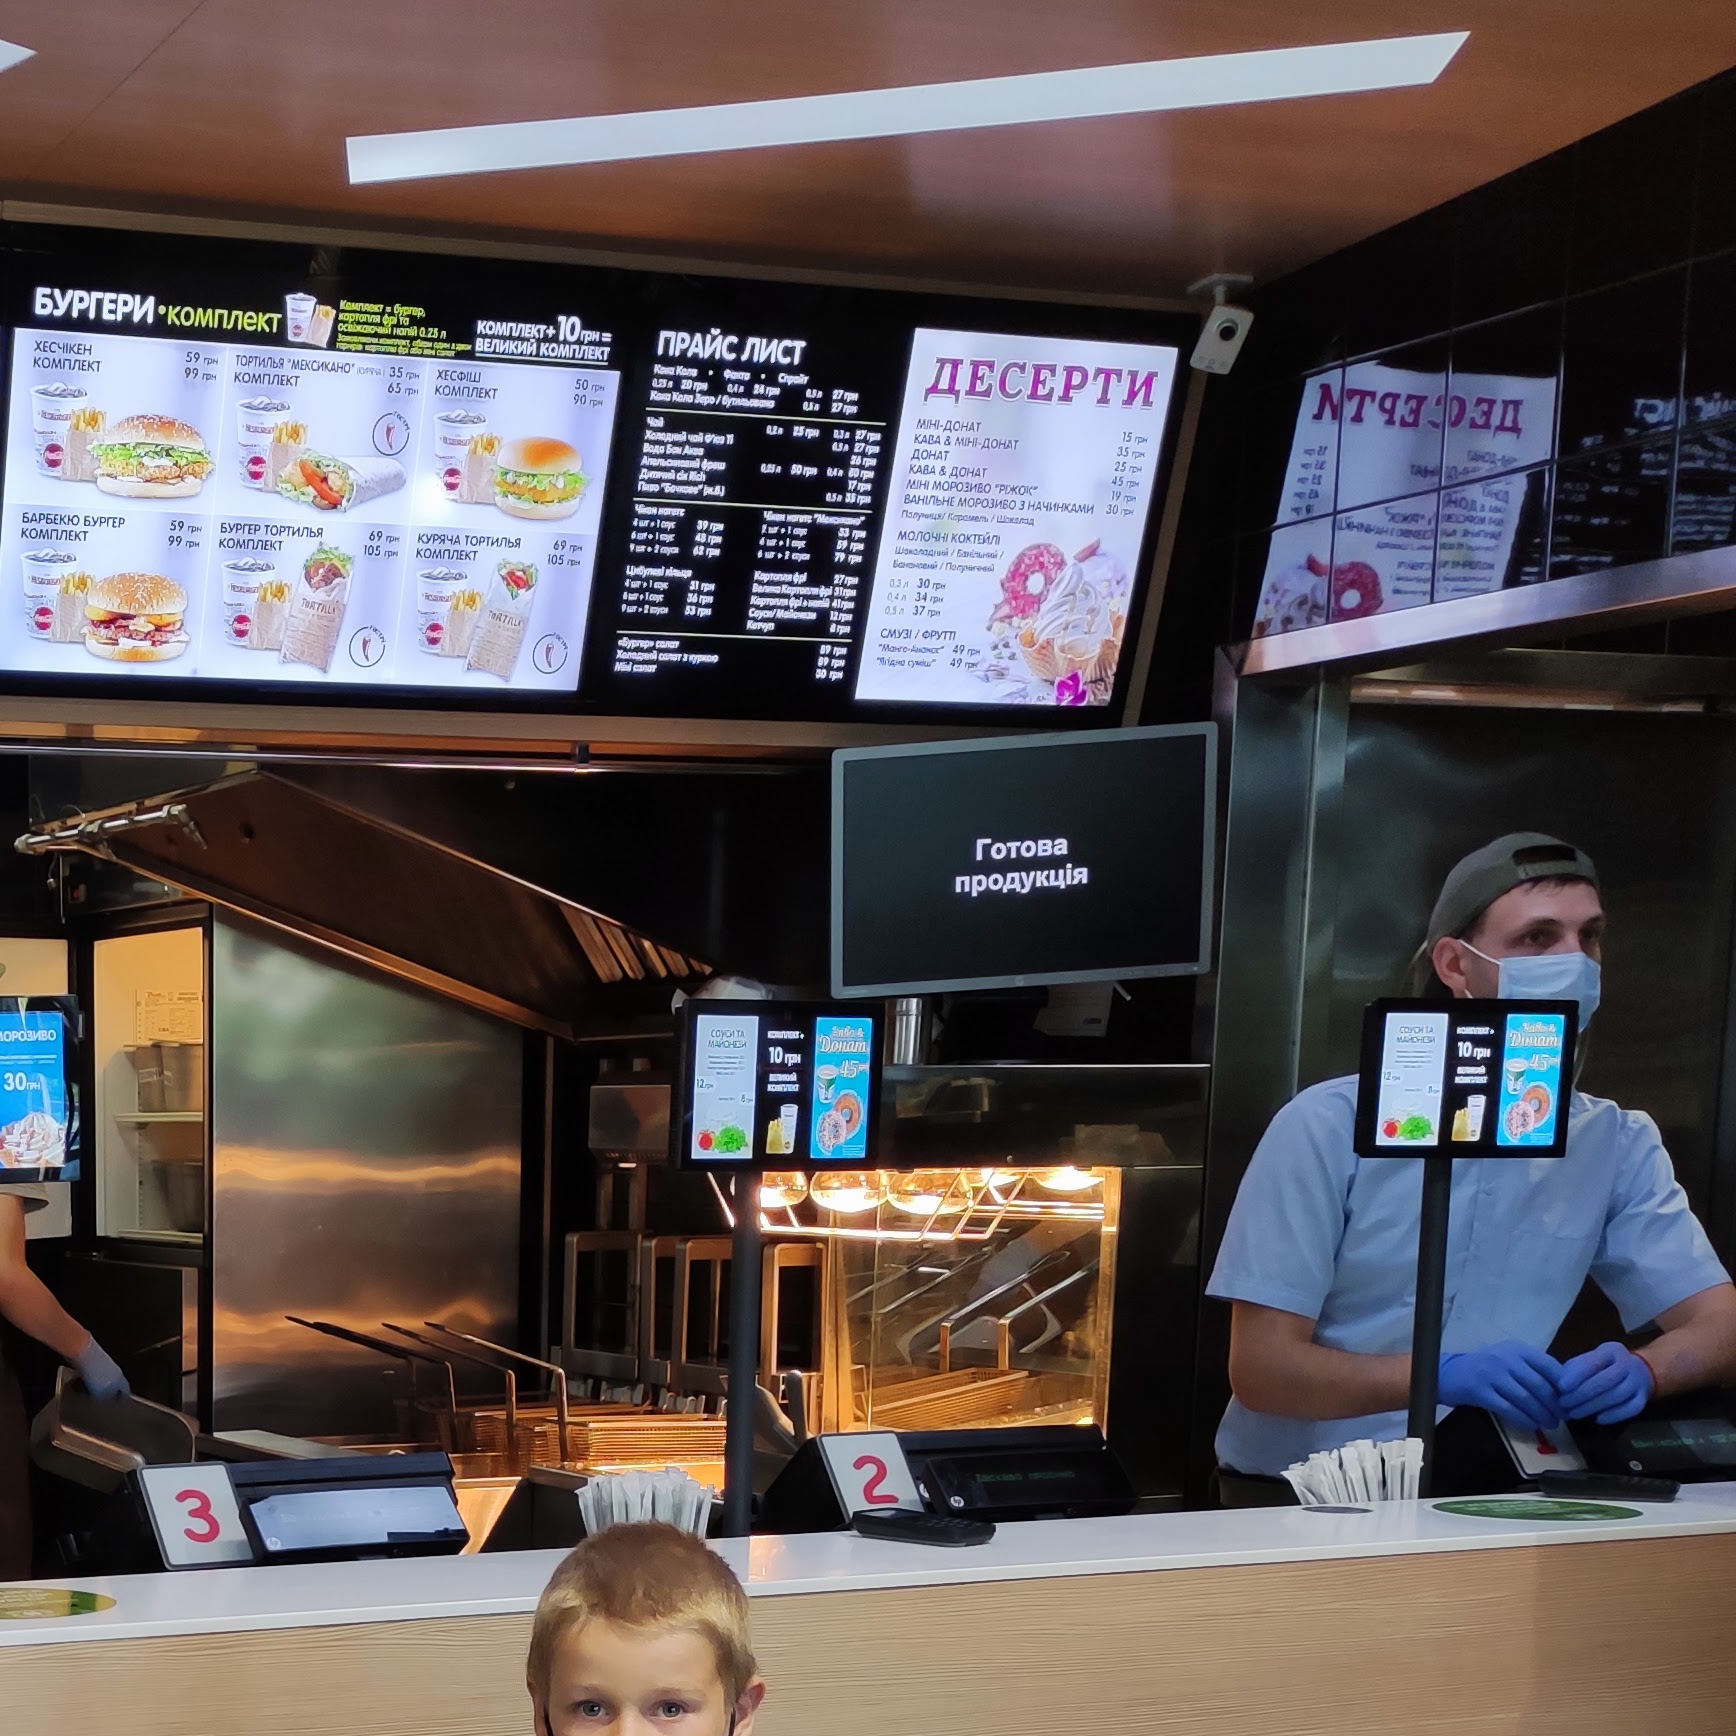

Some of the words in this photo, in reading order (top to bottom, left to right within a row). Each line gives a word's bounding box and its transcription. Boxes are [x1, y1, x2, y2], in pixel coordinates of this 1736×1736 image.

[34, 287, 154, 323] БУРГЕРИ
[557, 315, 580, 341] 10
[34, 340, 92, 356] ХЕСЧІКЕН
[476, 337, 536, 354] ВЕЛИКИЙ
[540, 342, 610, 361] КОМПЛЕКТ
[657, 328, 738, 360] ПРАЙС
[741, 336, 806, 365] ЛИСТ
[33, 357, 102, 373] КОМПЛЕКТ
[235, 354, 284, 369] ТОРТИЛЬЯ
[234, 372, 299, 387] КОМПЛЕКТ
[389, 366, 403, 378] 35
[437, 369, 481, 383] ХЕСФІШ
[388, 382, 402, 394] 65
[923, 357, 1158, 408] ДЕСЕРТИ
[435, 386, 498, 399] КОМПЛЕКТ
[916, 419, 981, 433] МІНІ-ДОНАТ
[914, 434, 941, 445] КАВА
[954, 437, 1019, 450] МІНІ-ДОНАТ
[1122, 432, 1132, 443] 15
[911, 450, 949, 461] ДОНАТ
[909, 464, 936, 475] КАВА
[949, 466, 987, 478] ДОНАТ
[932, 481, 991, 494] МОРОЗИВО
[904, 494, 954, 506] ВАНІЛЬНЕ
[958, 497, 1016, 510] МОРОЗИВО
[1028, 502, 1094, 515] НАЧИНКАМИ
[22, 512, 80, 526] БАРБЕКЮ
[84, 515, 125, 528] БУРГЕР
[21, 528, 88, 542] КОМПЛЕКТ
[220, 522, 261, 536] БУРГЕР
[264, 524, 323, 538] ТОРТИЛЬЯ
[898, 531, 948, 543] МОЛОЧНІ
[950, 532, 1000, 545] КОКТЕЙЛІ
[219, 538, 283, 552] КОМПЛЕКТ
[418, 533, 461, 546] КУРЯЧА
[465, 535, 521, 549] ТОРТИЛЬЯ
[416, 548, 478, 561] КОМПЛЕКТ
[881, 629, 912, 639] СМУЗІ
[975, 838, 1068, 861] Готова
[955, 863, 1089, 897] продукція
[768, 1047, 783, 1064] 10
[1458, 1042, 1472, 1058] 10
[840, 1060, 858, 1078] 45
[1529, 1055, 1548, 1071] 45
[4, 1073, 26, 1091] 30
[697, 1079, 704, 1089] 12
[853, 1454, 899, 1505] 2
[174, 1489, 220, 1544] 3
